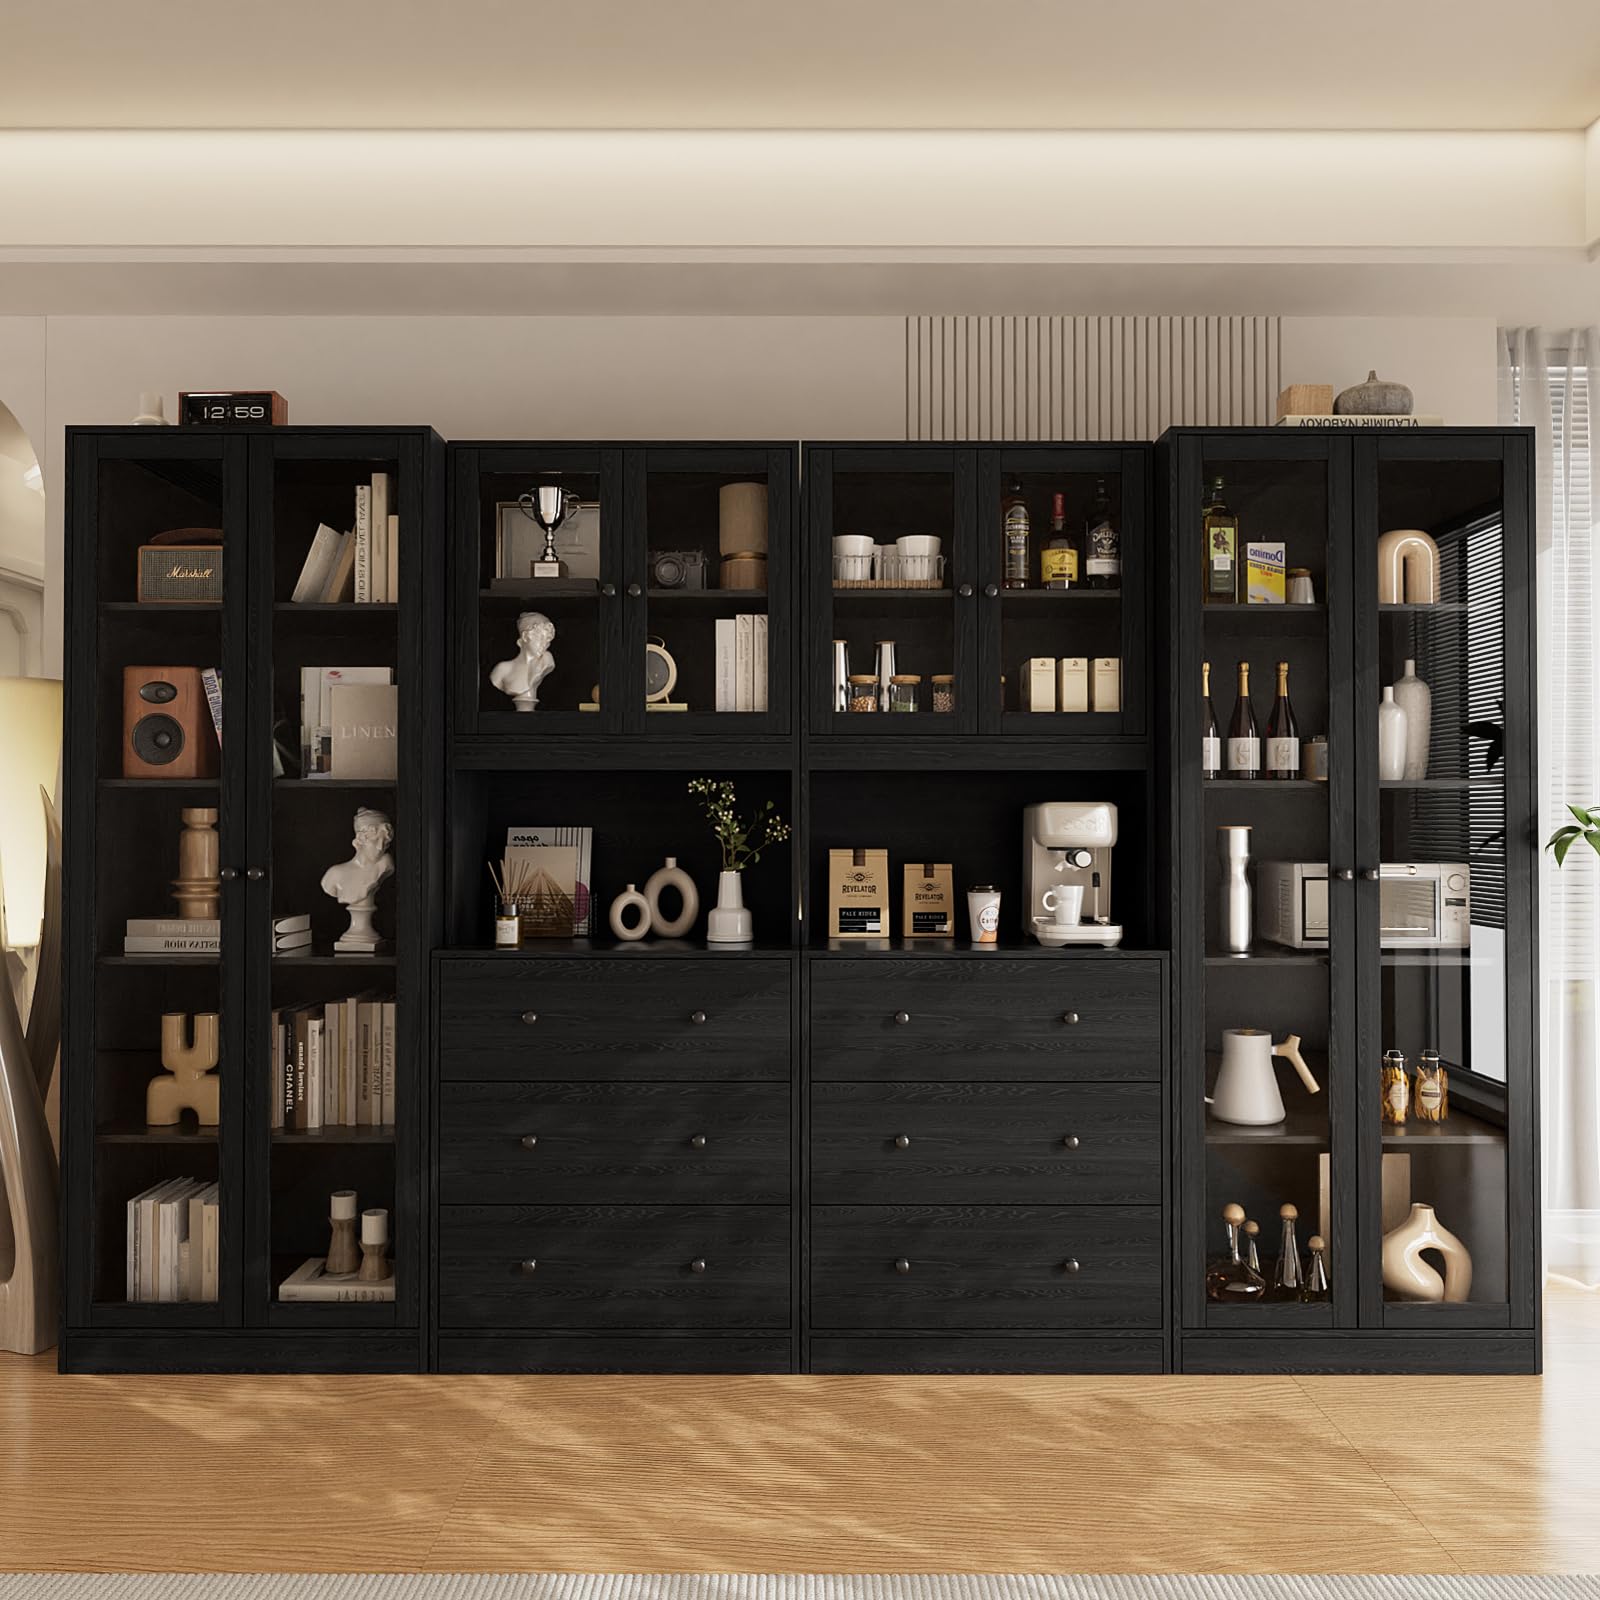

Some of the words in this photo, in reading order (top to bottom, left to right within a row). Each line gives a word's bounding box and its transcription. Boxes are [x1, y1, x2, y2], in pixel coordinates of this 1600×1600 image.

[1300, 418, 1359, 427] NABOKOV
[1361, 418, 1419, 427] VLADIMIR
[167, 565, 213, 577] Marshall
[341, 726, 395, 738] LINEN
[842, 884, 877, 894] REVELATOR
[915, 893, 944, 901] REVELATOR
[286, 1064, 294, 1112] CHANEL
